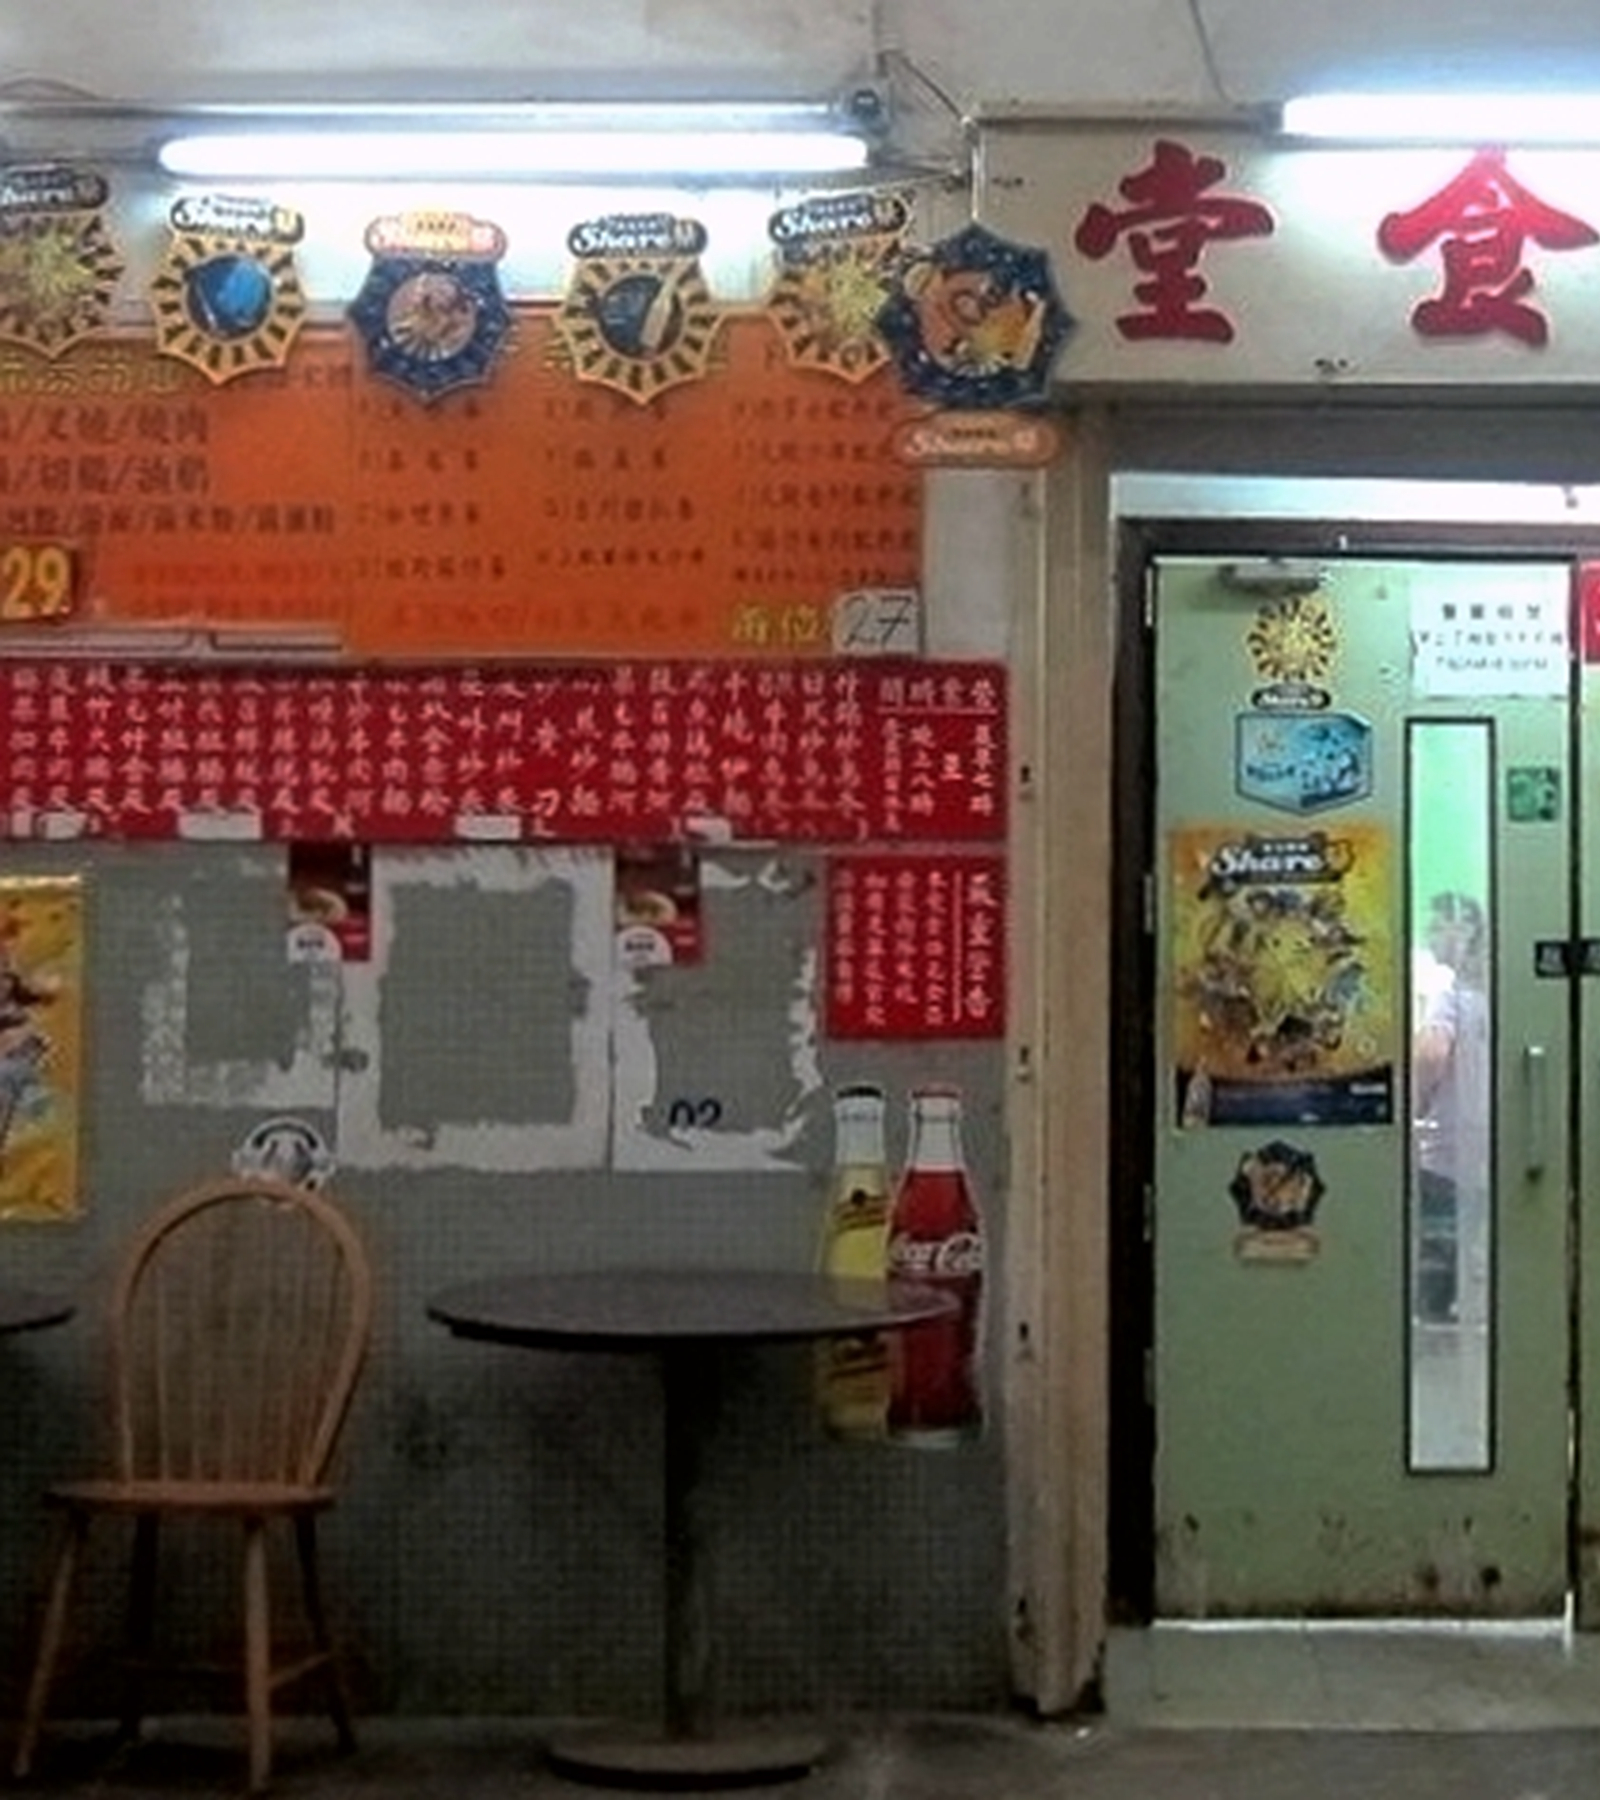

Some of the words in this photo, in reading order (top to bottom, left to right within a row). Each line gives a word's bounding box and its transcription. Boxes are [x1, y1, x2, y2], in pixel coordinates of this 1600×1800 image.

[573, 226, 671, 250] Share
[774, 208, 872, 238] Share
[2, 546, 71, 618] 29
[1212, 846, 1326, 877] Share
